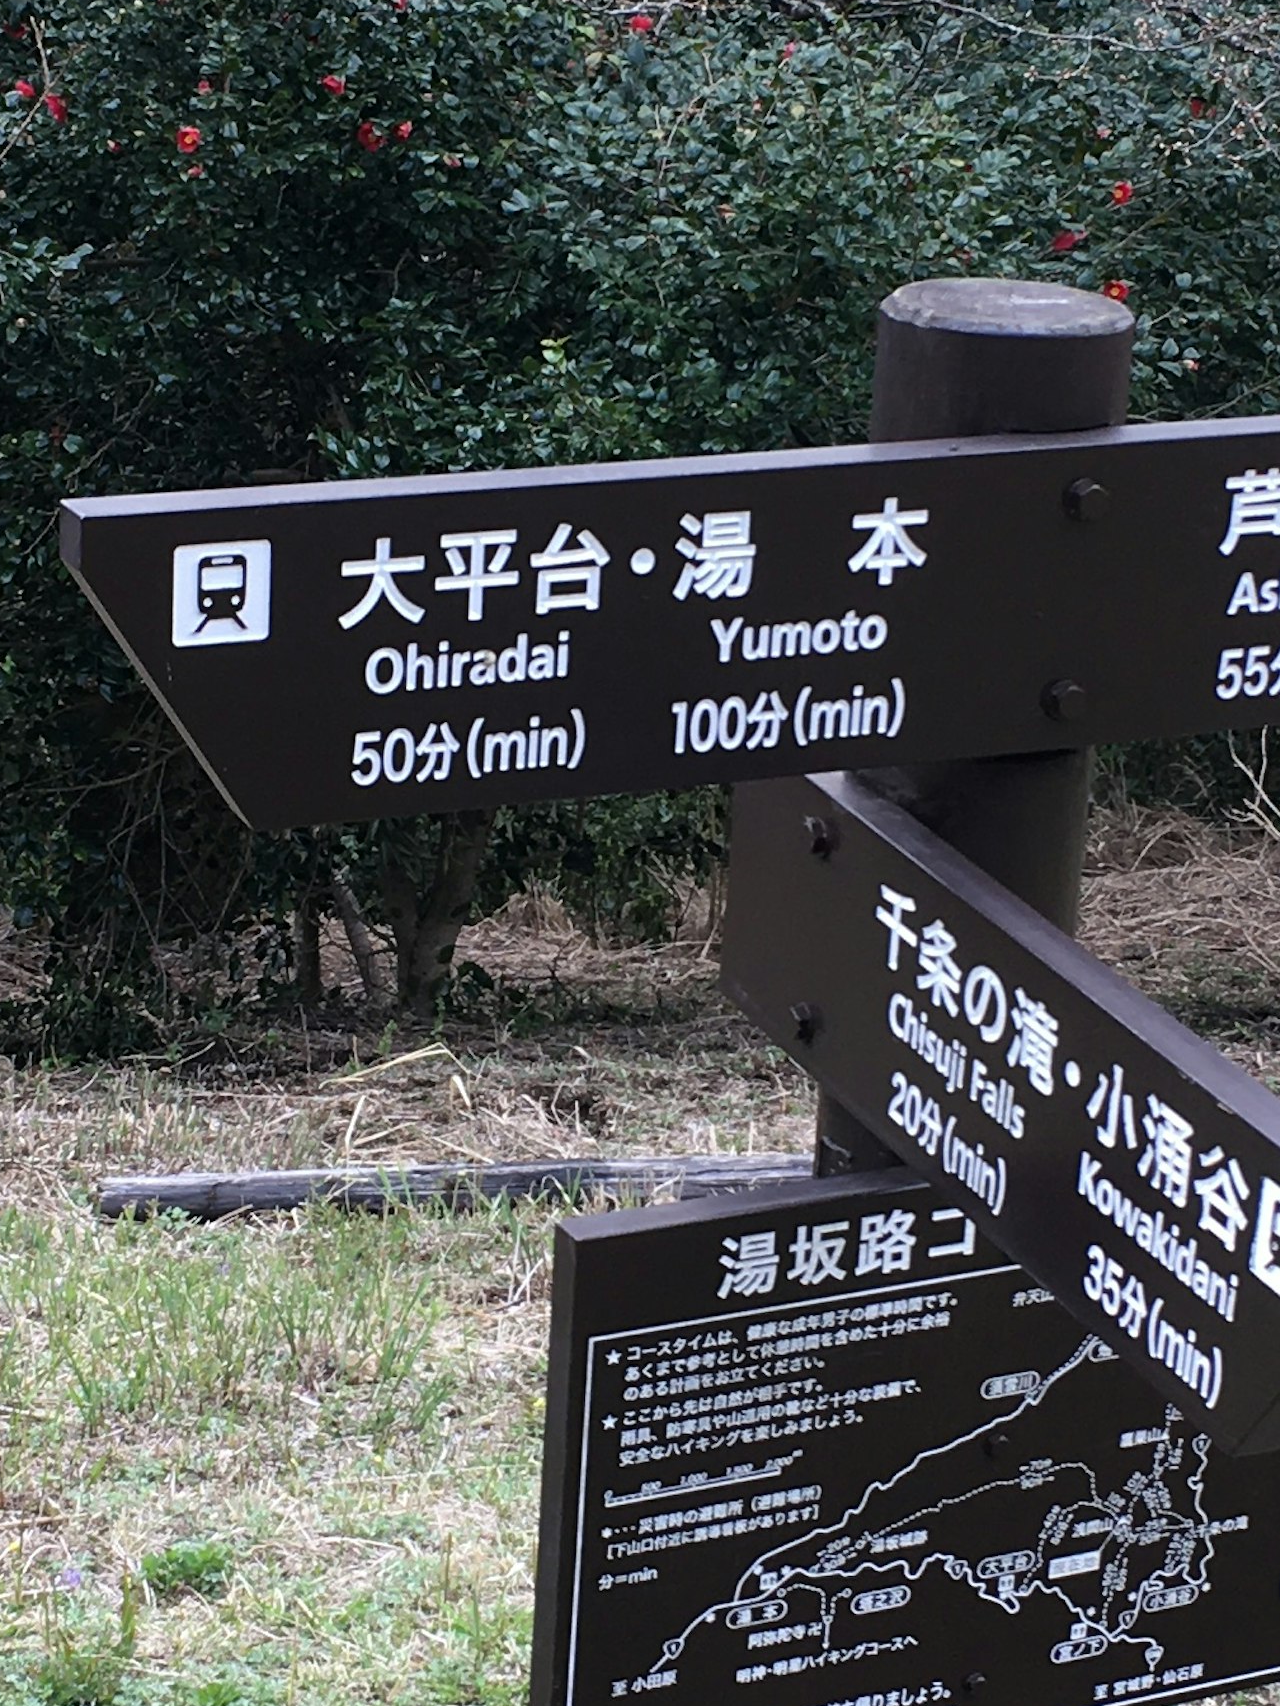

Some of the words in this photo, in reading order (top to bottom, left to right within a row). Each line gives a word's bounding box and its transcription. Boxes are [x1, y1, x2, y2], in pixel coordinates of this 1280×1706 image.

[364, 631, 571, 696] Ohiradai
[711, 610, 888, 665] Yumoto
[351, 707, 587, 788] 50分(min)
[671, 676, 906, 757] 100分(min)
[888, 992, 966, 1094] Chisuji
[969, 1058, 1026, 1141] Falls
[887, 1071, 1007, 1217] 20分(min)
[1077, 1150, 1240, 1323] Kowakidani
[1083, 1244, 1223, 1411] 35分(min)
